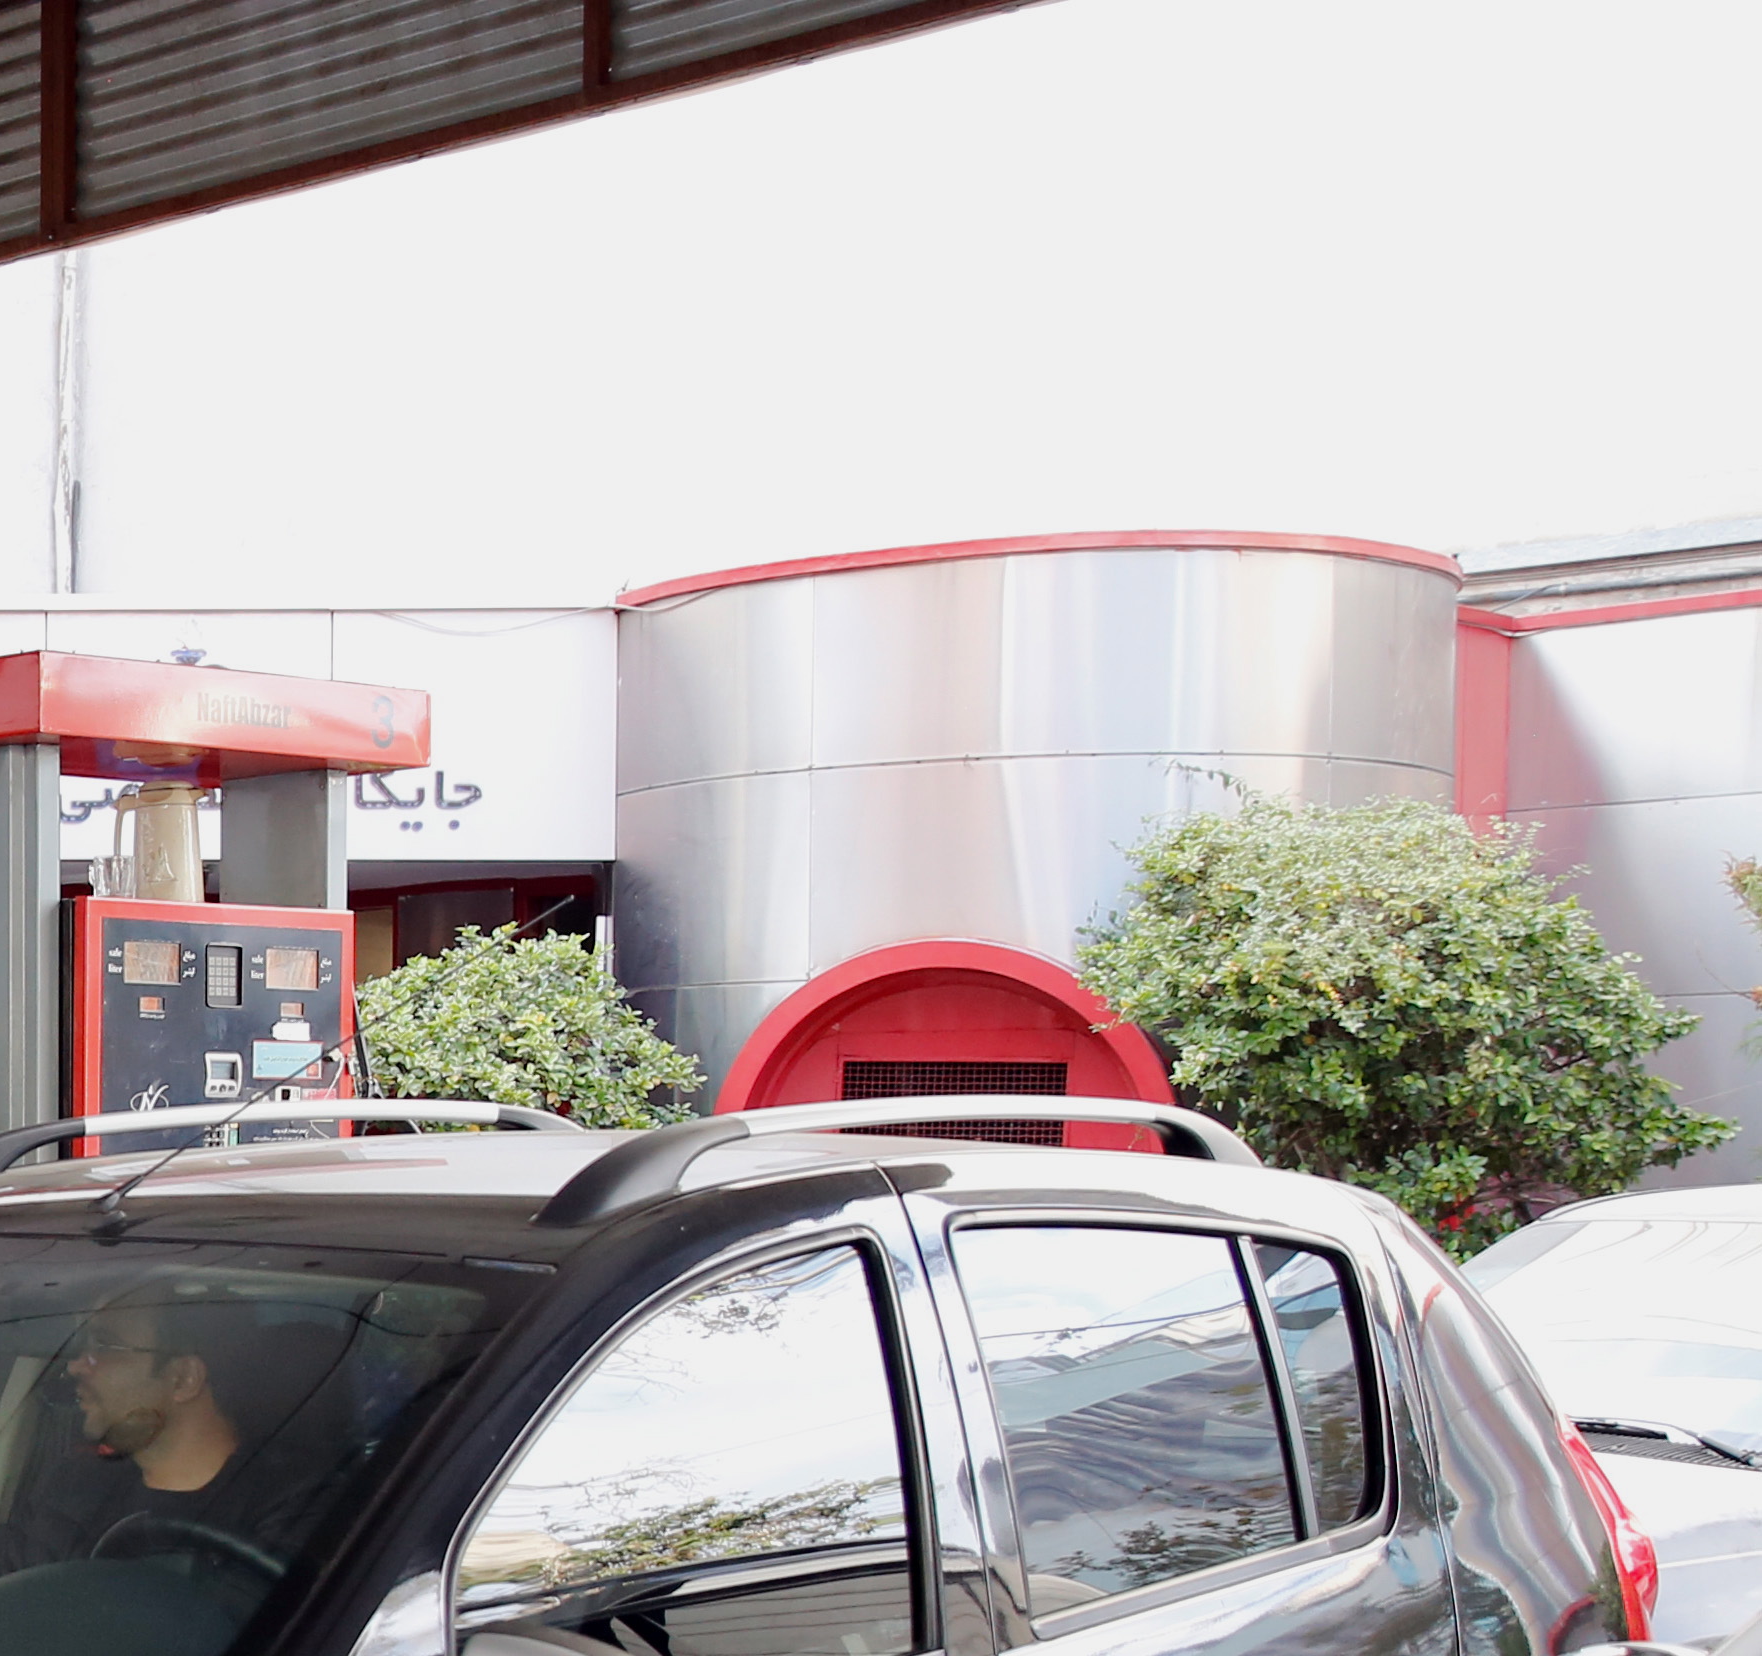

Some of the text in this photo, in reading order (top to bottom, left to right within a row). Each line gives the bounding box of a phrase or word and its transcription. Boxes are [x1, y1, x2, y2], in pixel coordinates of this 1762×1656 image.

[196, 691, 395, 750] NaftAbzar 3
[354, 770, 483, 832] جایگا
